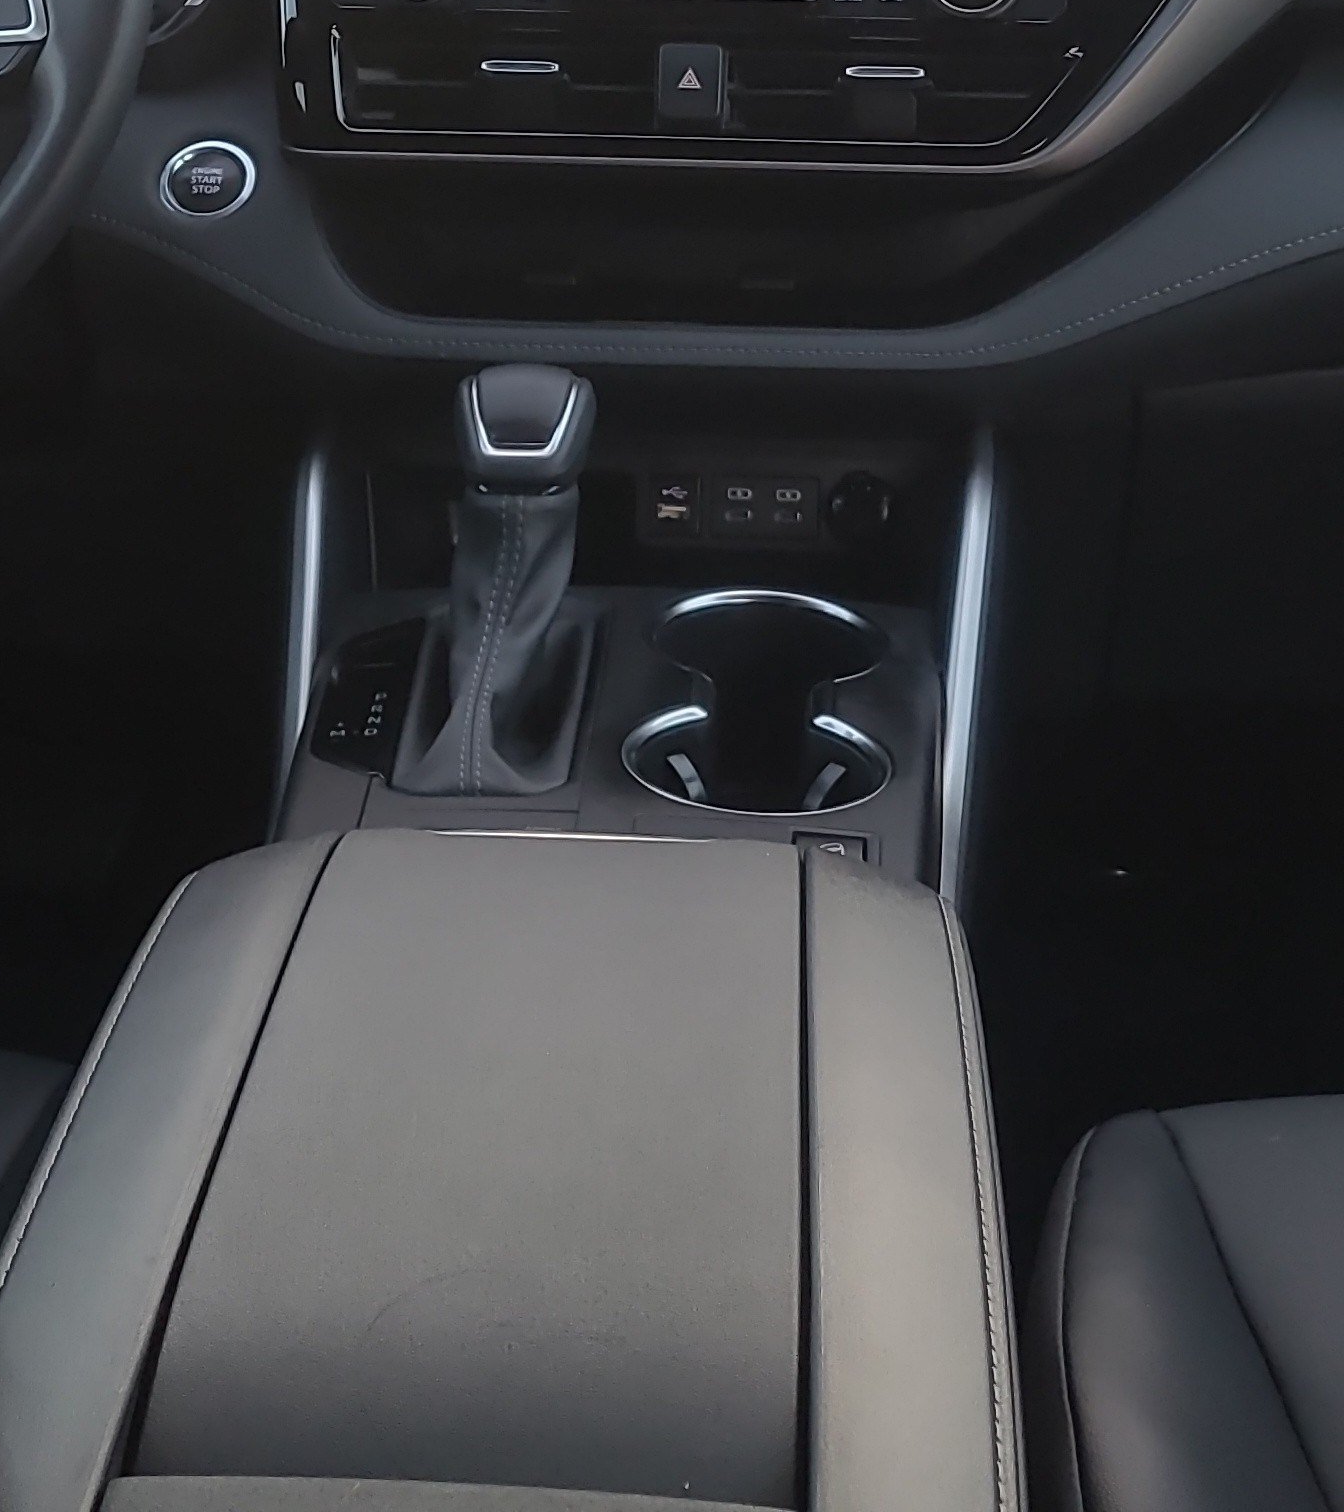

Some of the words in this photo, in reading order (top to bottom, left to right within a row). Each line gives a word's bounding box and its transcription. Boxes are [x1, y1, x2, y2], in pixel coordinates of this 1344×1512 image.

[191, 167, 223, 175] ENGINE
[191, 175, 223, 185] START
[191, 185, 221, 194] STOP
